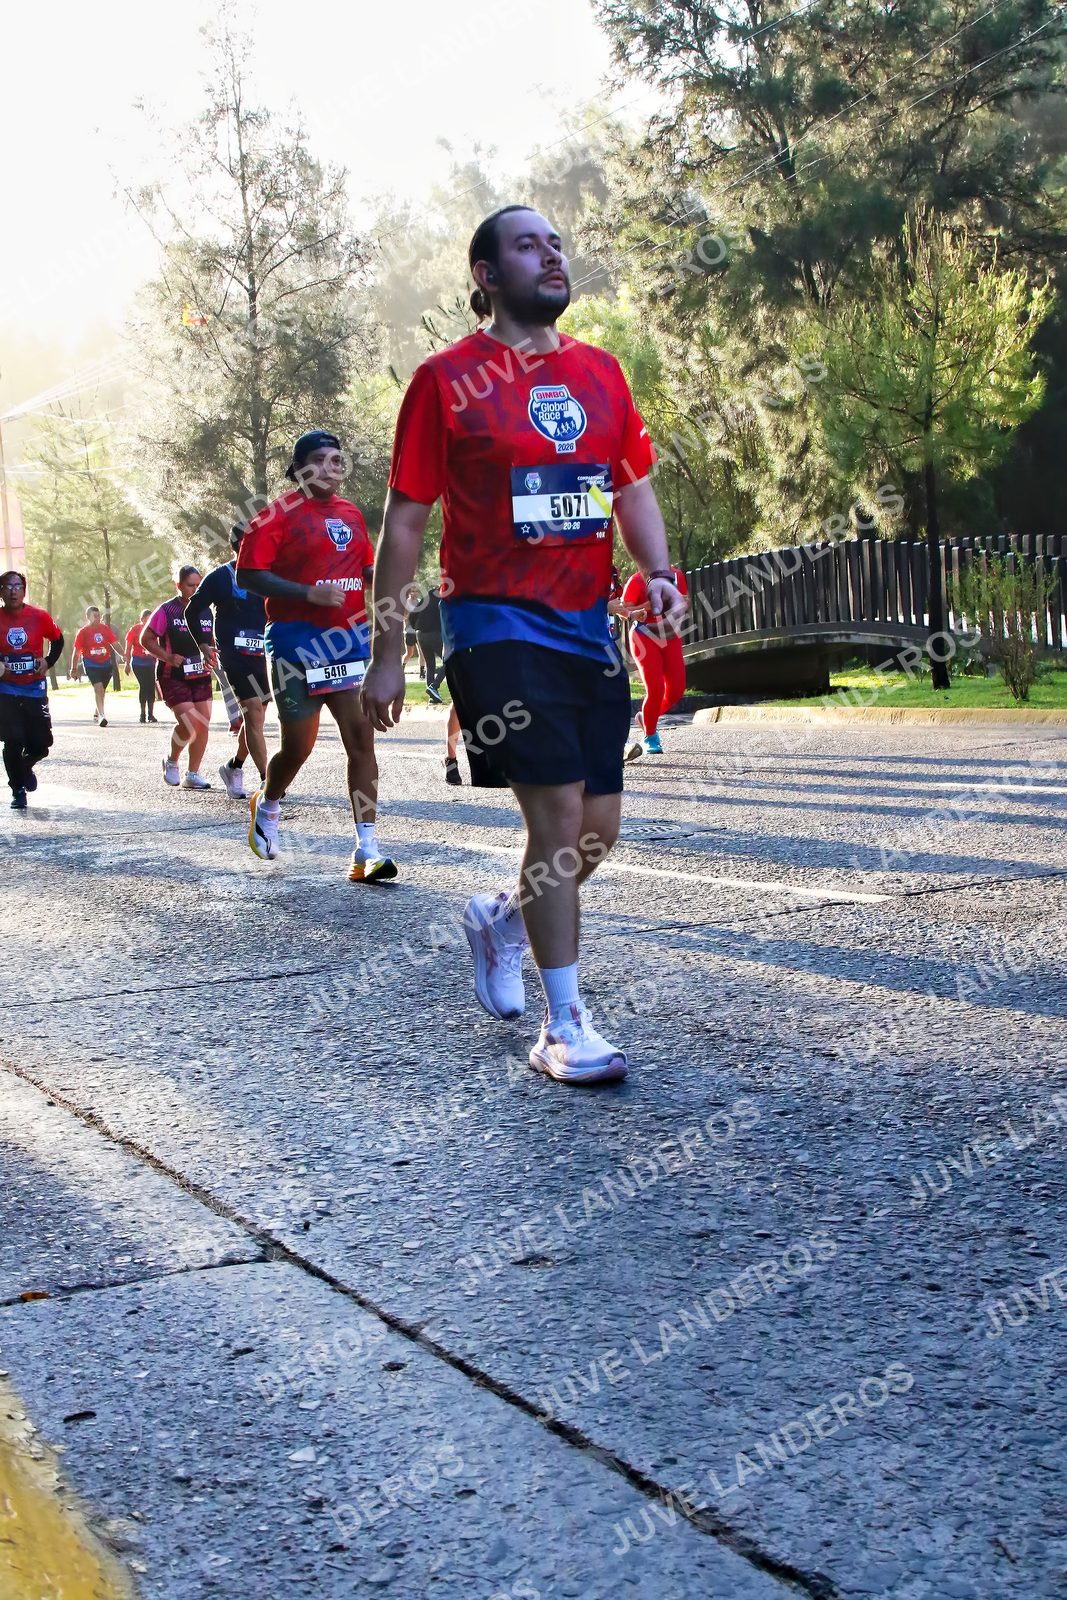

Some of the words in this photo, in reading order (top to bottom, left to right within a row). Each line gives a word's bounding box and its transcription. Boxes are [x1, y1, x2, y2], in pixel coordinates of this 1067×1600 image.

[535, 391, 566, 399] BIMBO
[541, 401, 569, 412] Global
[538, 412, 561, 421] Race
[557, 443, 574, 452] 2026
[550, 495, 589, 518] 5071
[324, 665, 347, 679] 5418
